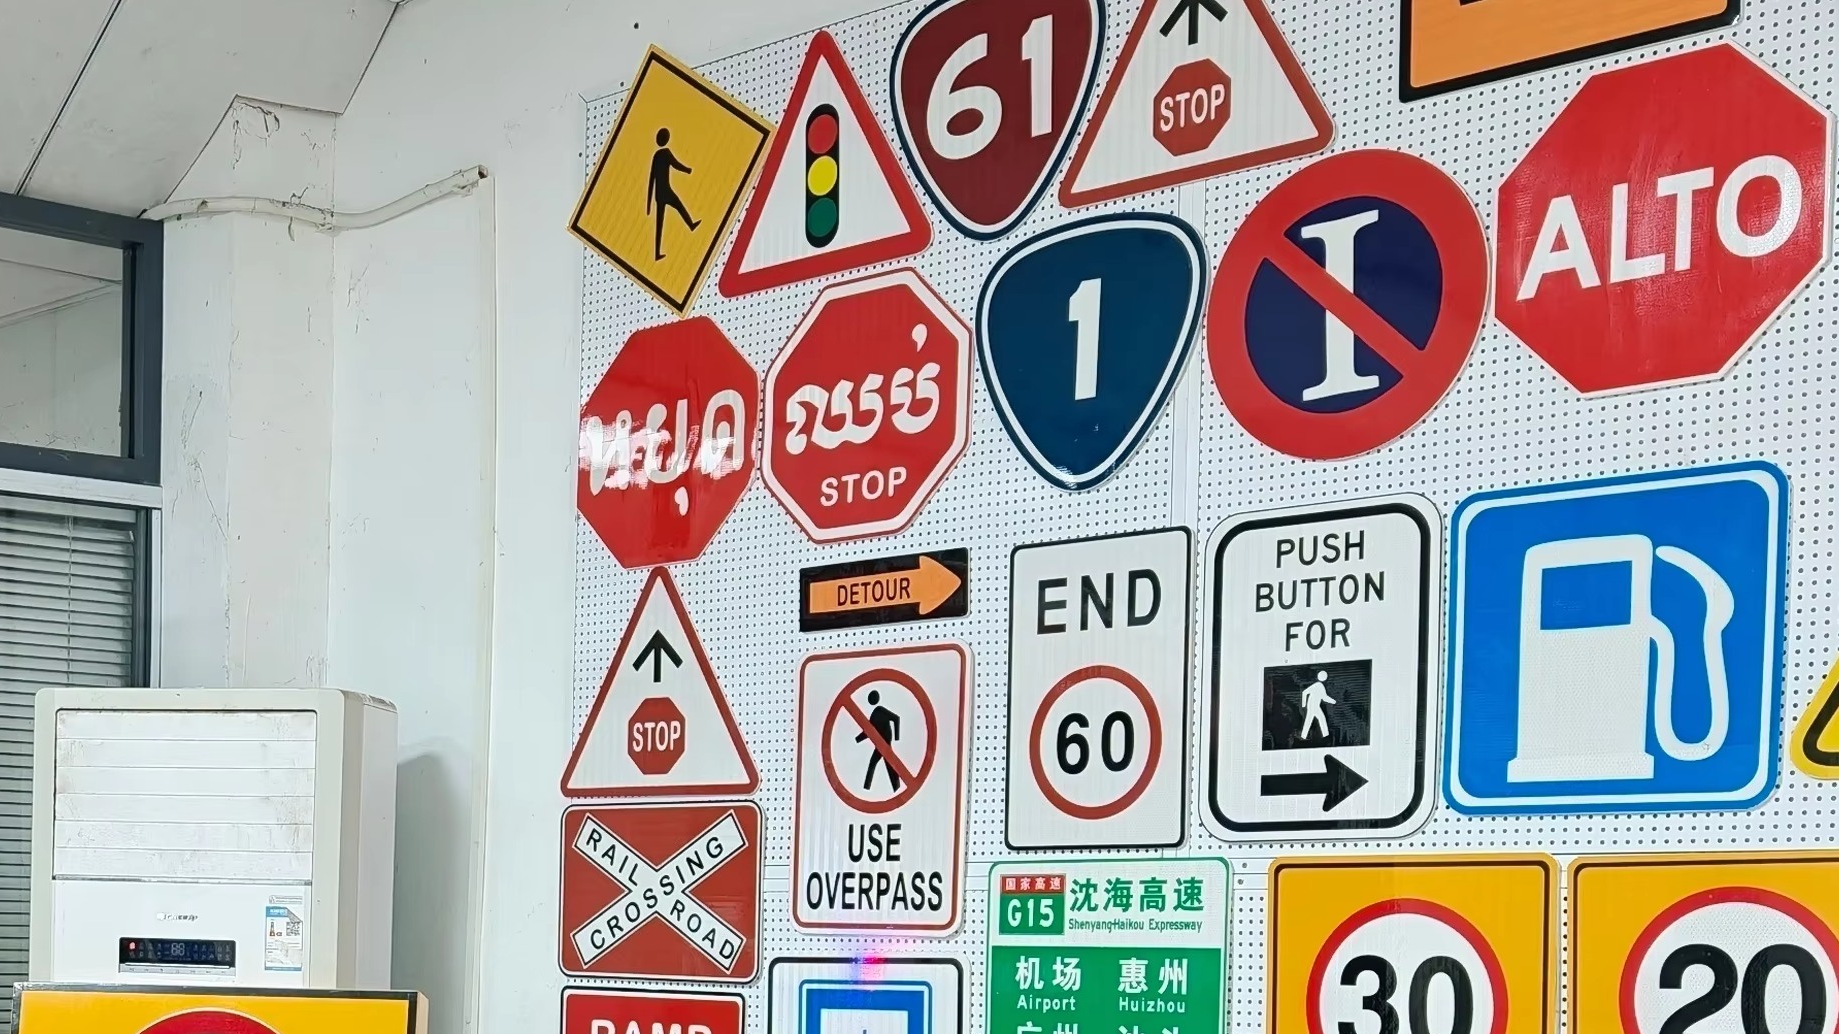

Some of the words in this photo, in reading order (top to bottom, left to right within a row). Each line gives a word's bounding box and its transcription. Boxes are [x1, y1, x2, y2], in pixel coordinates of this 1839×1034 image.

[927, 14, 1054, 160] 61
[1160, 84, 1225, 132] STOP
[1516, 154, 1803, 302] ALTO
[1068, 278, 1102, 401] 1
[820, 466, 907, 507] STOP
[1276, 531, 1365, 569] PUSH
[836, 577, 911, 607] DETOUR
[1036, 568, 1162, 635] END
[1255, 570, 1385, 613] BUTTON
[1284, 619, 1351, 652] FOR
[632, 719, 682, 753] STOP
[1057, 710, 1135, 775] 60
[586, 828, 639, 886] RAIL
[848, 823, 902, 864] USE
[590, 836, 724, 950] CROSSING
[806, 872, 944, 912] OVERPASS
[1005, 876, 1062, 891] 国家高速
[1070, 876, 1205, 913] 沈海高速
[670, 899, 736, 960] ROAD
[1007, 898, 1055, 928] G15
[1149, 919, 1203, 933] Expressway
[1015, 955, 1082, 992] 机场
[1117, 957, 1189, 995] 惠州
[1017, 994, 1076, 1013] Airport
[1118, 997, 1186, 1013] Huizhou
